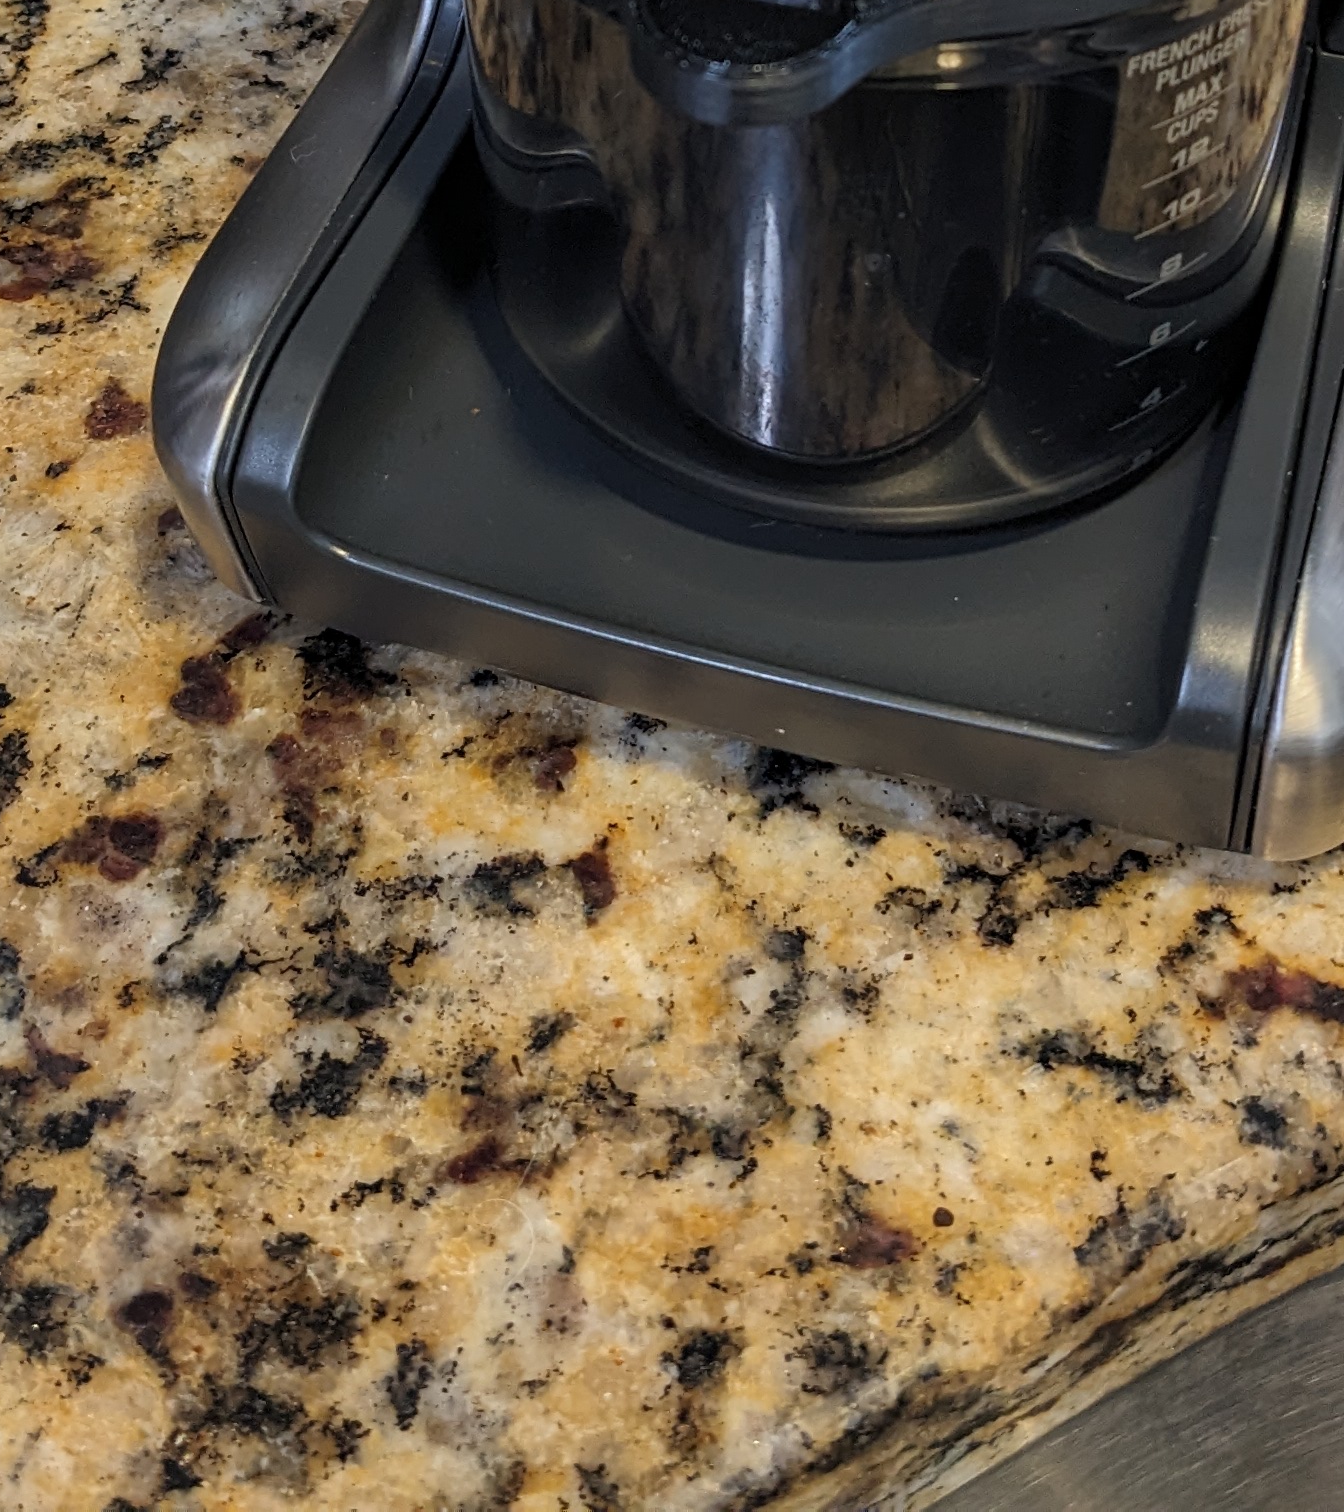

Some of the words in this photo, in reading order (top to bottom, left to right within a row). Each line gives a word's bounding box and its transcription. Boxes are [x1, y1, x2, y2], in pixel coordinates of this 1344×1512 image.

[1126, 26, 1214, 79] FRENCH
[1156, 28, 1248, 92] PLUNGER
[1174, 70, 1224, 116] MAX
[1166, 100, 1219, 144] CUPS
[1171, 135, 1210, 170] 12
[1162, 188, 1202, 219] 10
[1149, 321, 1171, 347] 6
[1139, 387, 1162, 409] 4
